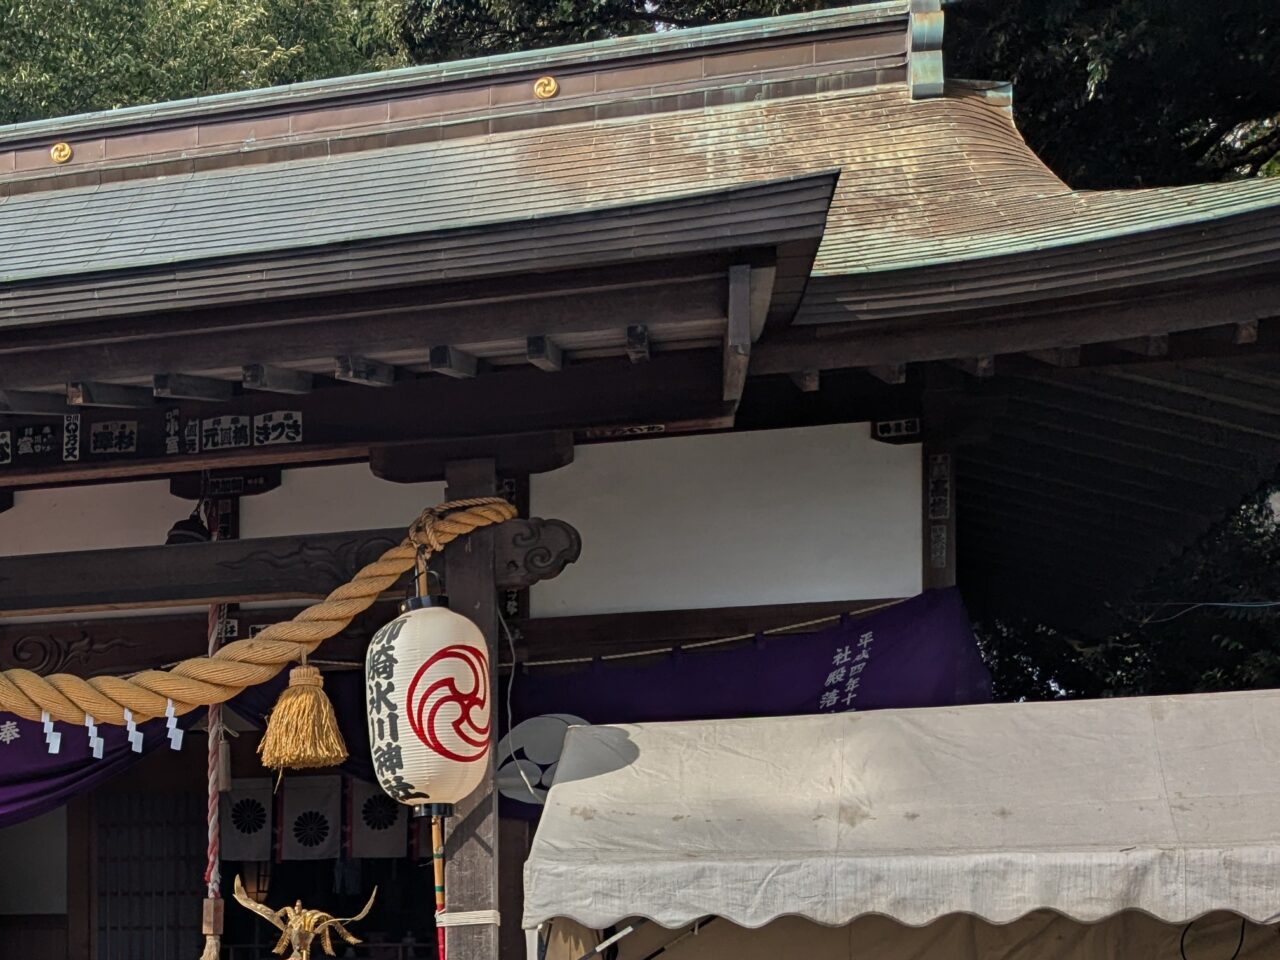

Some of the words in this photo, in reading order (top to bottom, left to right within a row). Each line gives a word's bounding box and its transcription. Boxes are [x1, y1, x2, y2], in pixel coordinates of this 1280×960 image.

[368, 616, 430, 801] 柳崎氷川神社
[820, 647, 852, 713] 社殿落
